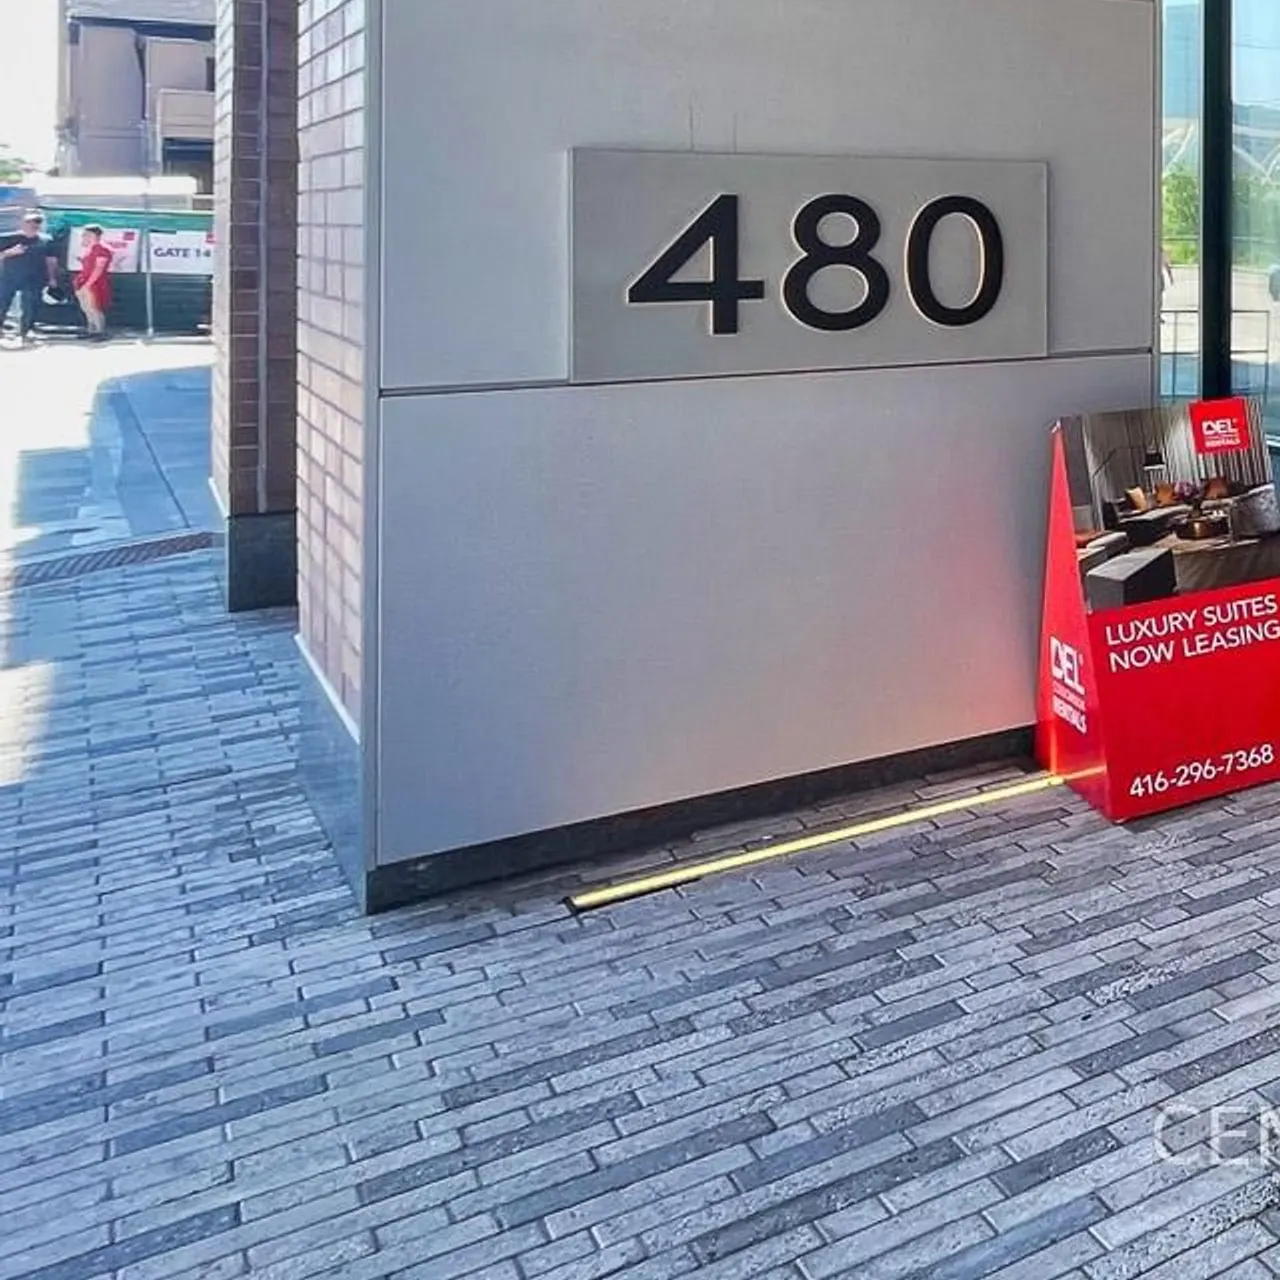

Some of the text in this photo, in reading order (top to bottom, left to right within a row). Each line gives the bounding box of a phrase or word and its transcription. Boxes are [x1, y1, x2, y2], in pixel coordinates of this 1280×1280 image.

[153, 247, 191, 258] GATE
[627, 193, 1004, 337] 480
[1106, 594, 1278, 646] LUXURY SUITES
[1109, 640, 1175, 673] NOW
[1129, 743, 1274, 798] 416-296-7368
